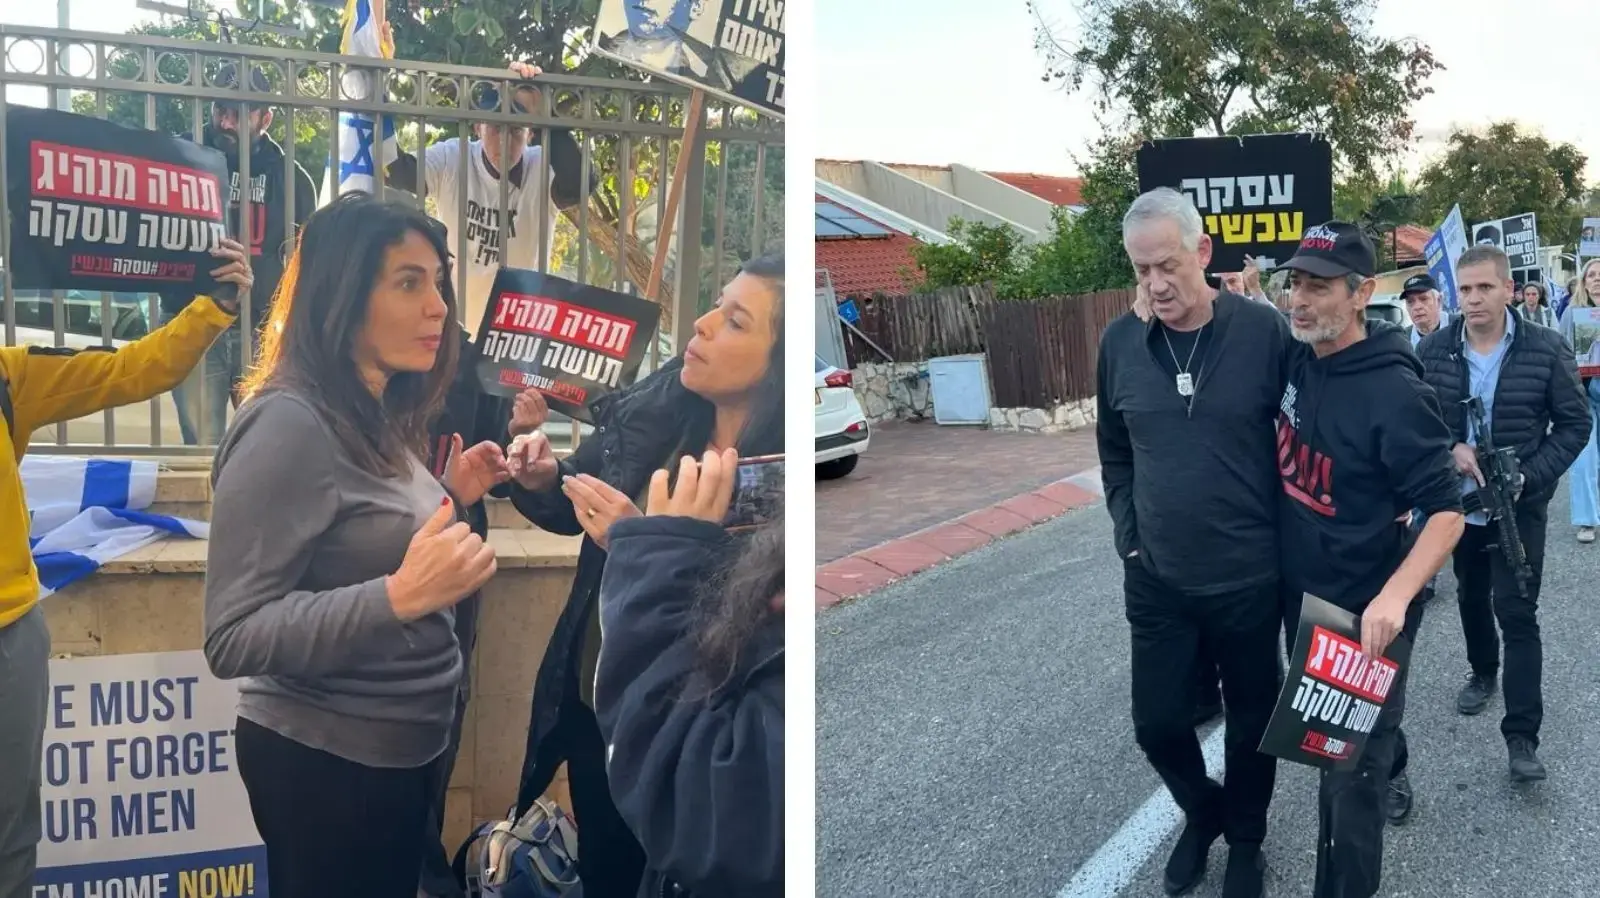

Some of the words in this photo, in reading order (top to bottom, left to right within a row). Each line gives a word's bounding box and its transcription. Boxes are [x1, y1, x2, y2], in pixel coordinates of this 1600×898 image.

[720, 18, 782, 68] אותם
[37, 149, 136, 201] מנהיג
[148, 167, 219, 214] תהיה
[1181, 174, 1294, 214] עסקה
[29, 200, 128, 247] עסקה
[138, 213, 225, 253] תעשה
[1205, 211, 1303, 244] עכשי
[495, 297, 558, 331] מנהיג
[560, 309, 631, 352] תהיה
[482, 330, 541, 363] עסקה
[542, 341, 624, 388] תעשה
[1310, 633, 1369, 690] מנהיג
[53, 684, 76, 729] E
[90, 677, 199, 726] MUST
[1291, 675, 1352, 723] עסקה
[46, 740, 95, 787] OT
[106, 730, 236, 782] FORGE
[46, 797, 97, 843] UR
[111, 788, 196, 838] MEN
[178, 863, 255, 898] NOW!
